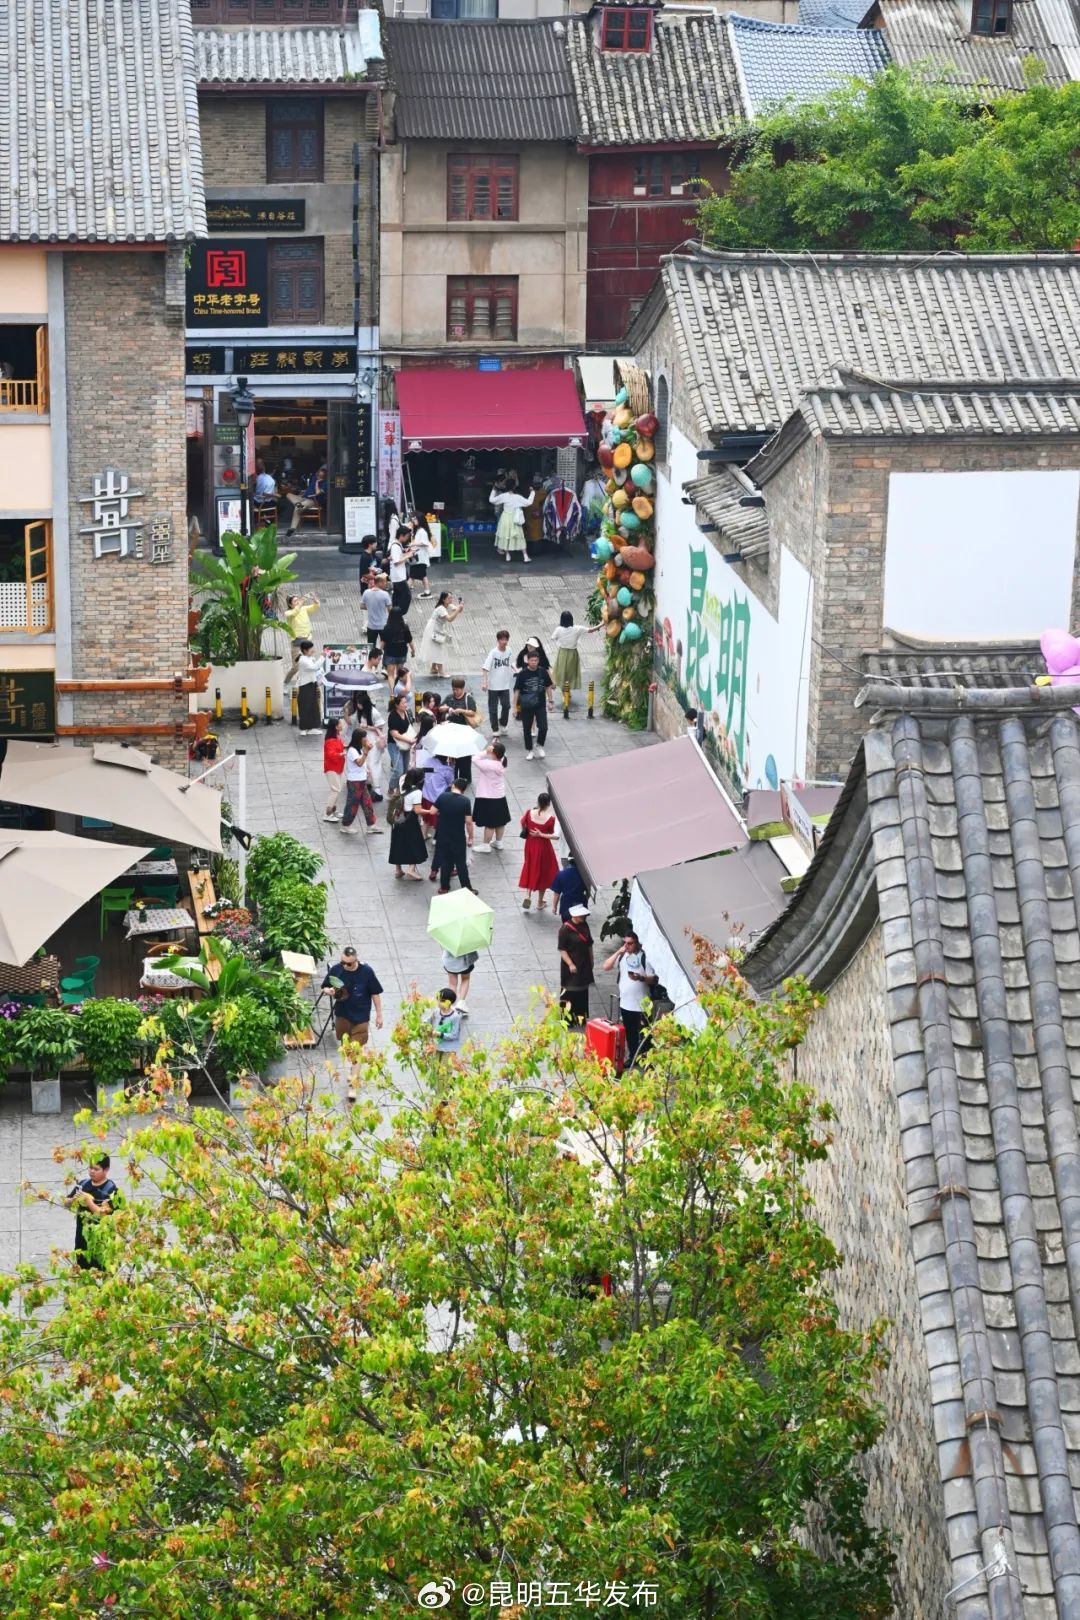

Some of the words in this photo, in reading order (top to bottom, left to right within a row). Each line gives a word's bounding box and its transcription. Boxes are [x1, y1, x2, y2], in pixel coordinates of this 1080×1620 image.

[193, 293, 261, 306] 中华老字号
[193, 307, 209, 315] China
[246, 307, 261, 315] Brand
[384, 421, 396, 446] 刻章
[686, 544, 751, 772] 昆明
